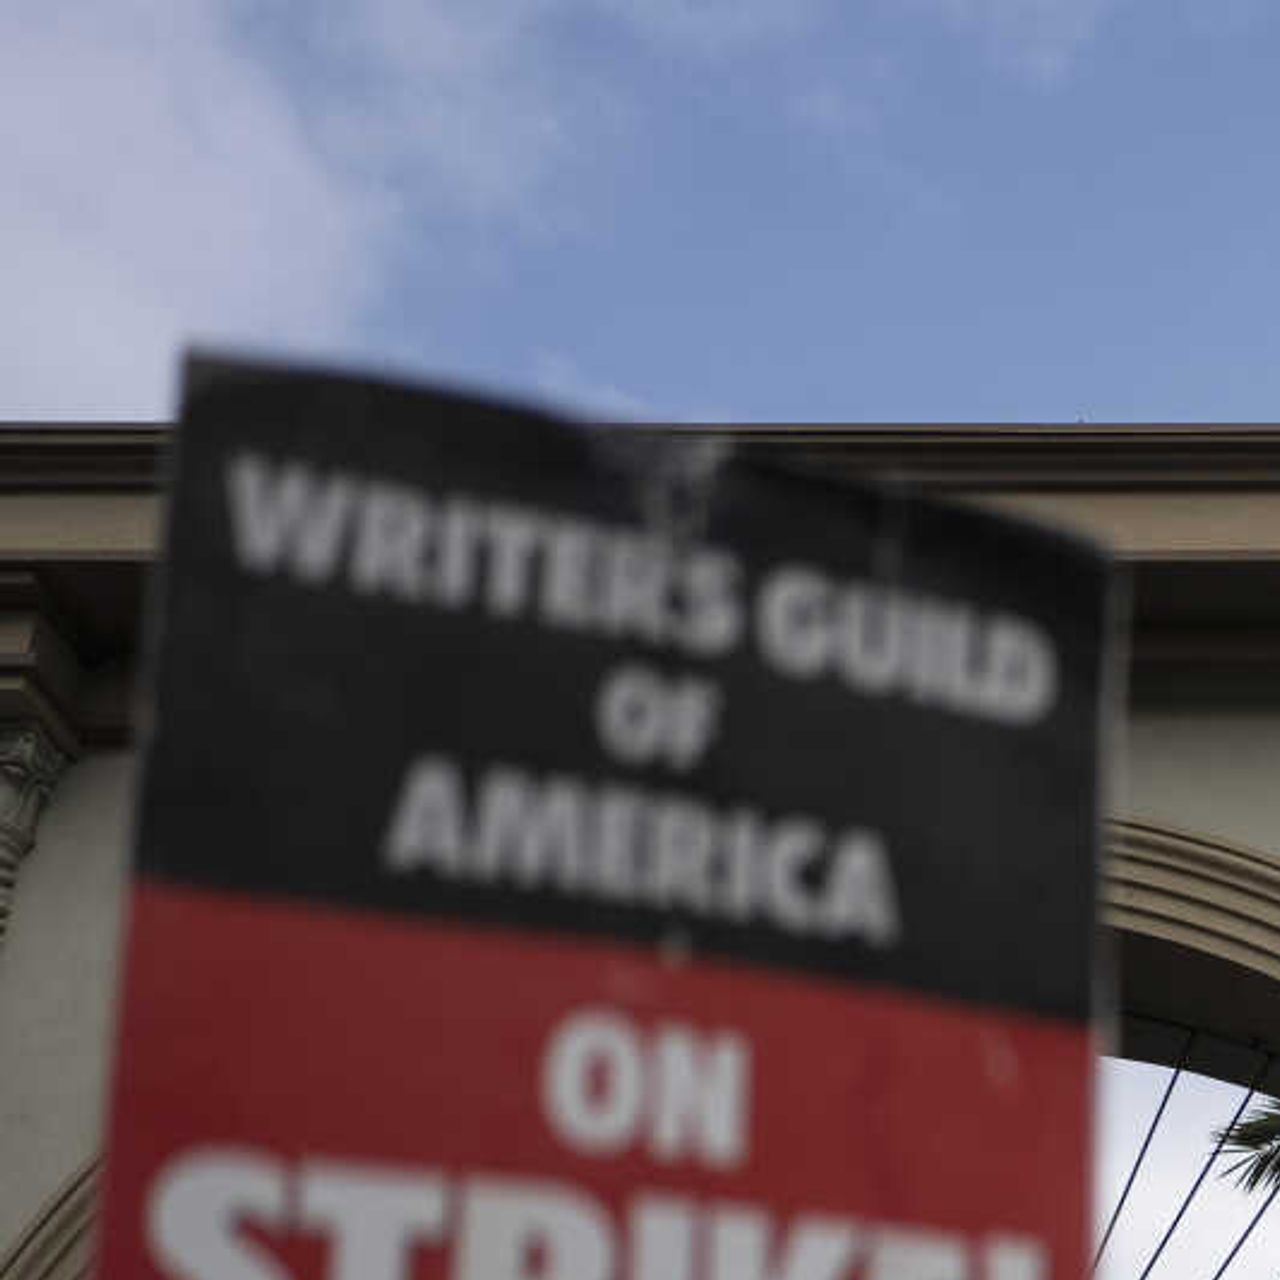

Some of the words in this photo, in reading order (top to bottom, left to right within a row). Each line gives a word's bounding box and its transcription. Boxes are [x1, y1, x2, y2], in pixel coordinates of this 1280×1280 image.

[226, 453, 747, 660] WRITERS
[755, 563, 1059, 727] GUILD
[597, 668, 725, 772] OF
[385, 757, 899, 947] AMERICA
[543, 1010, 751, 1167] ON
